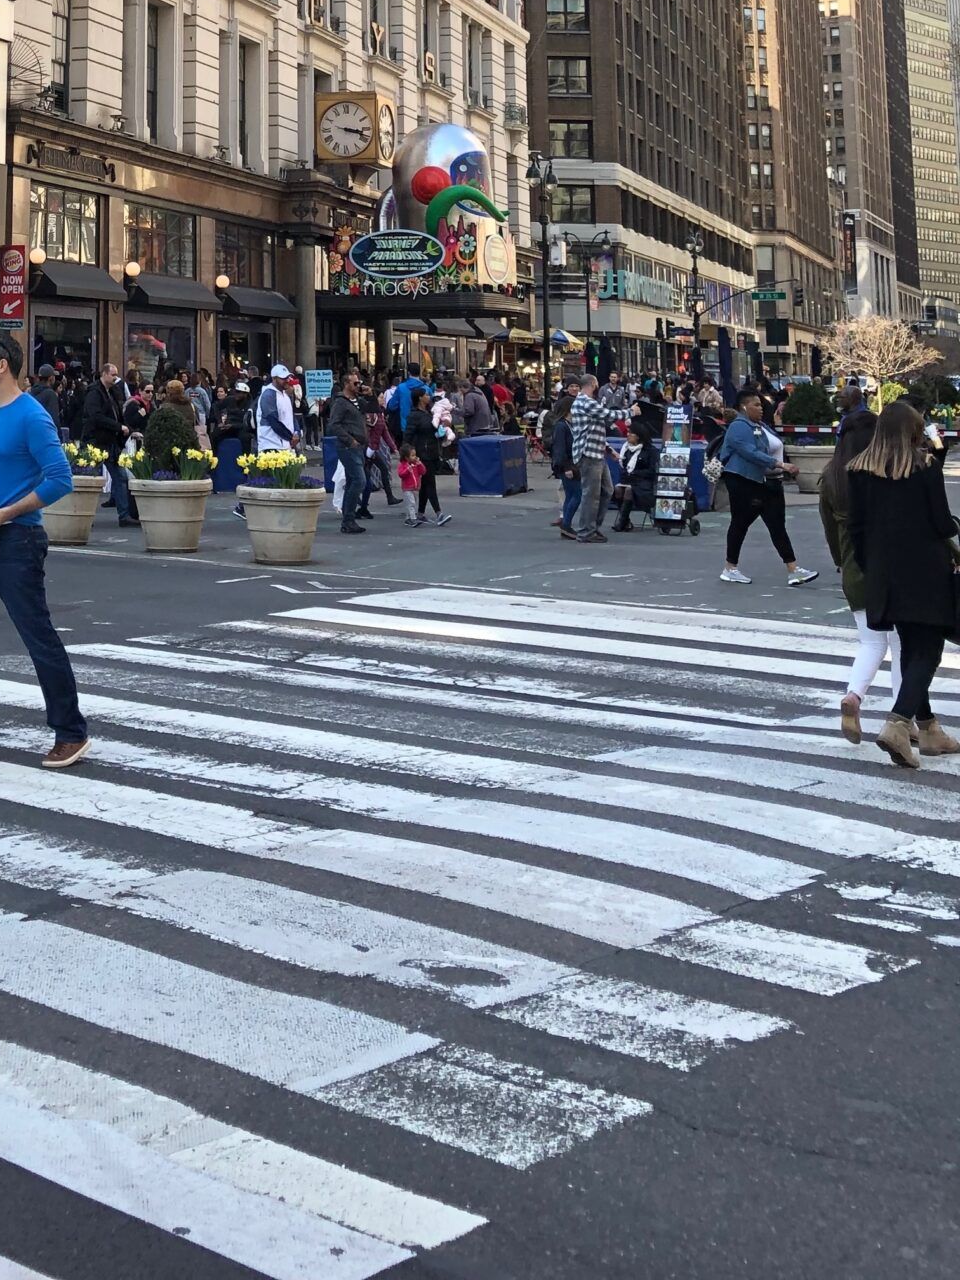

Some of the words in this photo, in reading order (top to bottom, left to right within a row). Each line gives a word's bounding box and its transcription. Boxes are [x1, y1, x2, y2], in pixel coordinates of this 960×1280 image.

[374, 239, 421, 249] JOURNEY
[5, 258, 22, 267] KING
[3, 275, 23, 285] NOW
[1, 285, 24, 294] OPEN
[363, 277, 429, 300] macy's
[666, 413, 689, 421] Family
